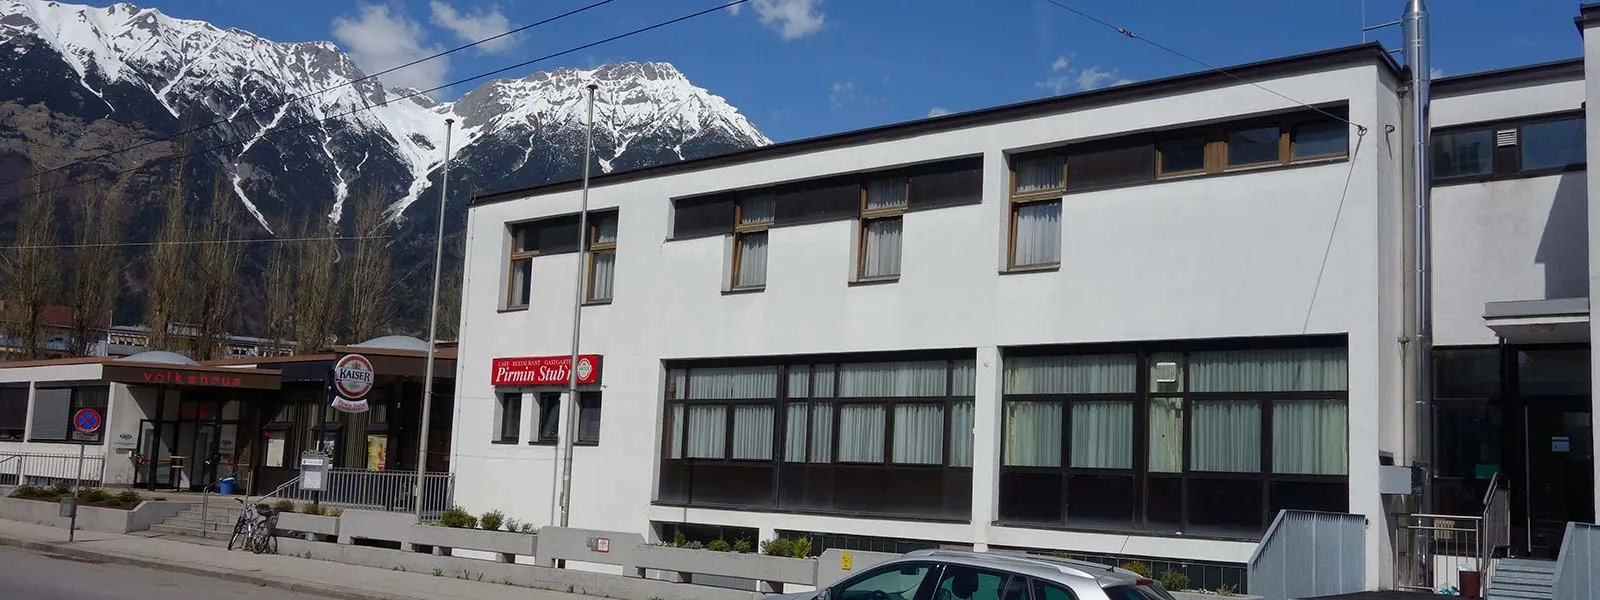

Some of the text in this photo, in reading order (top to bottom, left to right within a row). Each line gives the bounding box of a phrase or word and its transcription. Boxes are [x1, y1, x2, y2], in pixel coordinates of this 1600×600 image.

[511, 359, 541, 367] RESTAURANT
[143, 371, 242, 386] volkshaus
[339, 368, 371, 382] KAISER
[495, 366, 535, 382] Pirmin
